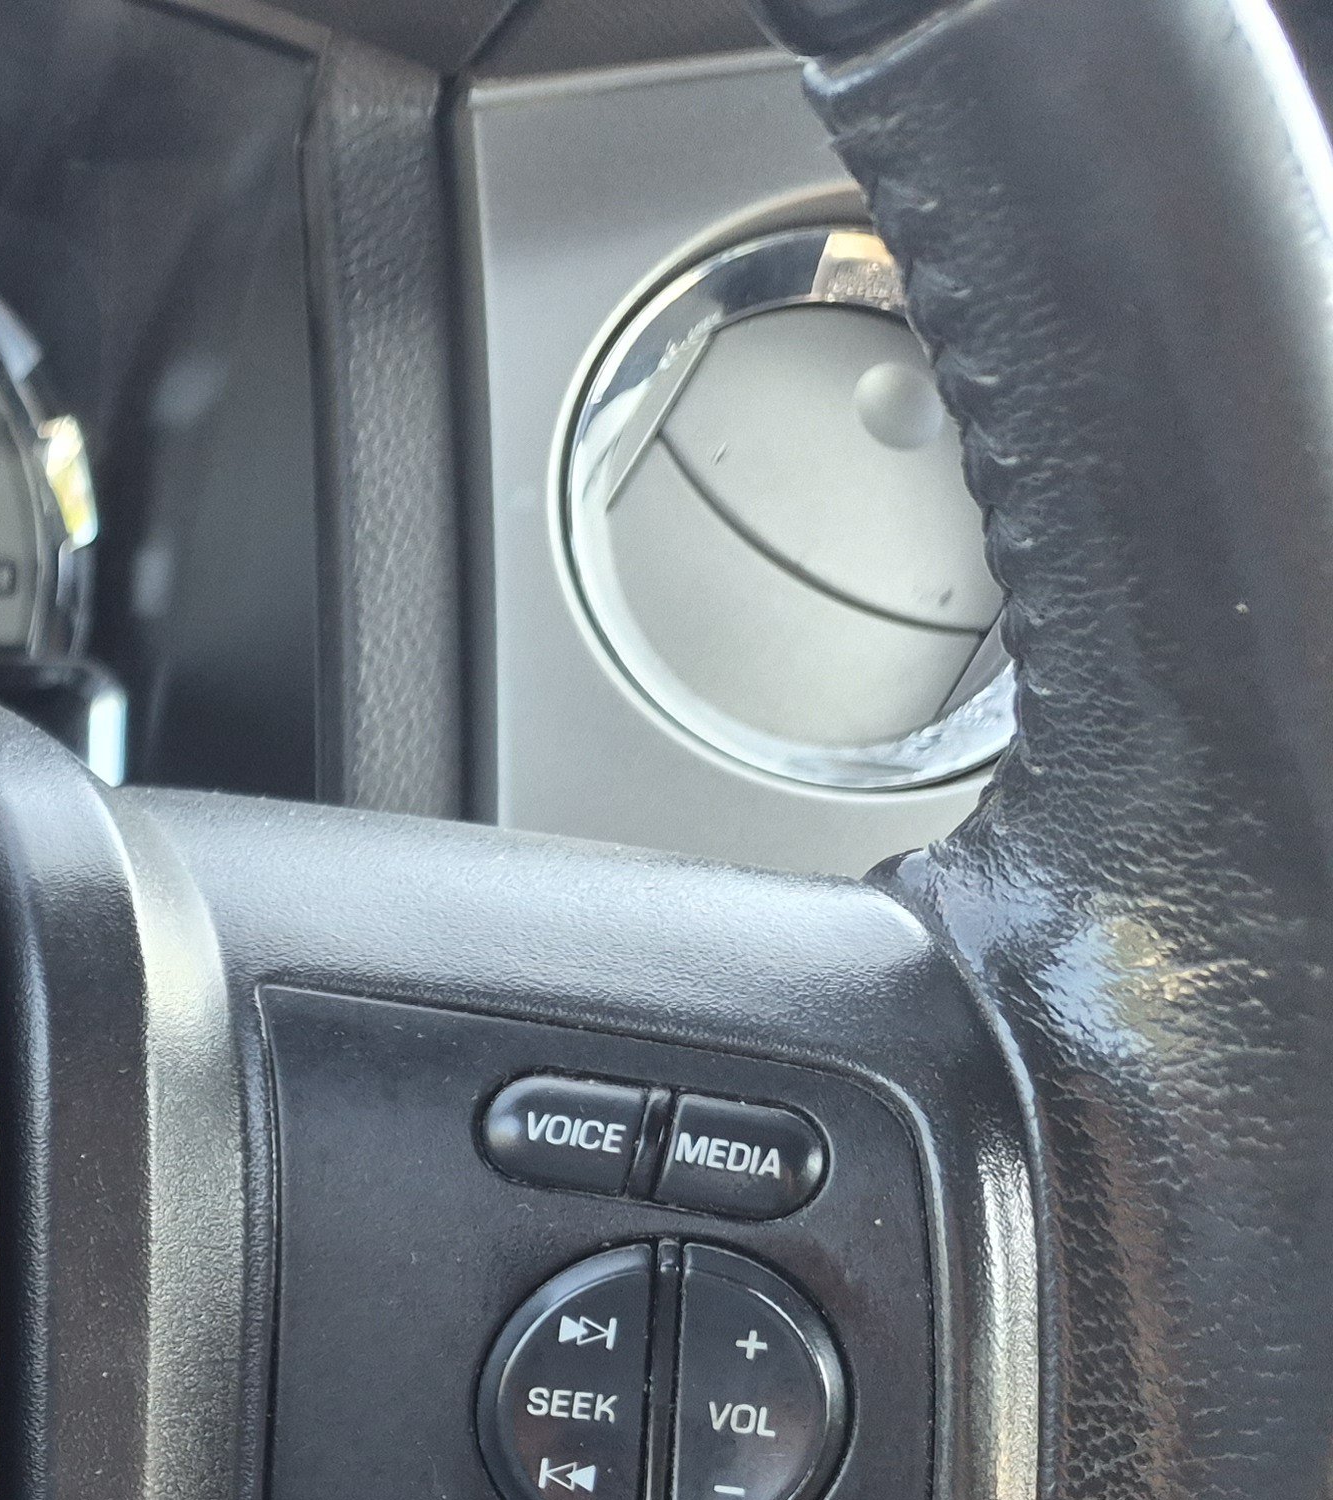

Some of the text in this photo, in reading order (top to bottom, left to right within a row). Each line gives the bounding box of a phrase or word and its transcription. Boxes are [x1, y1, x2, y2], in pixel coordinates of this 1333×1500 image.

[526, 1110, 627, 1154] VOICE
[673, 1131, 783, 1178] MEDIA
[526, 1386, 618, 1424] SEEK
[707, 1400, 776, 1439] VOL
